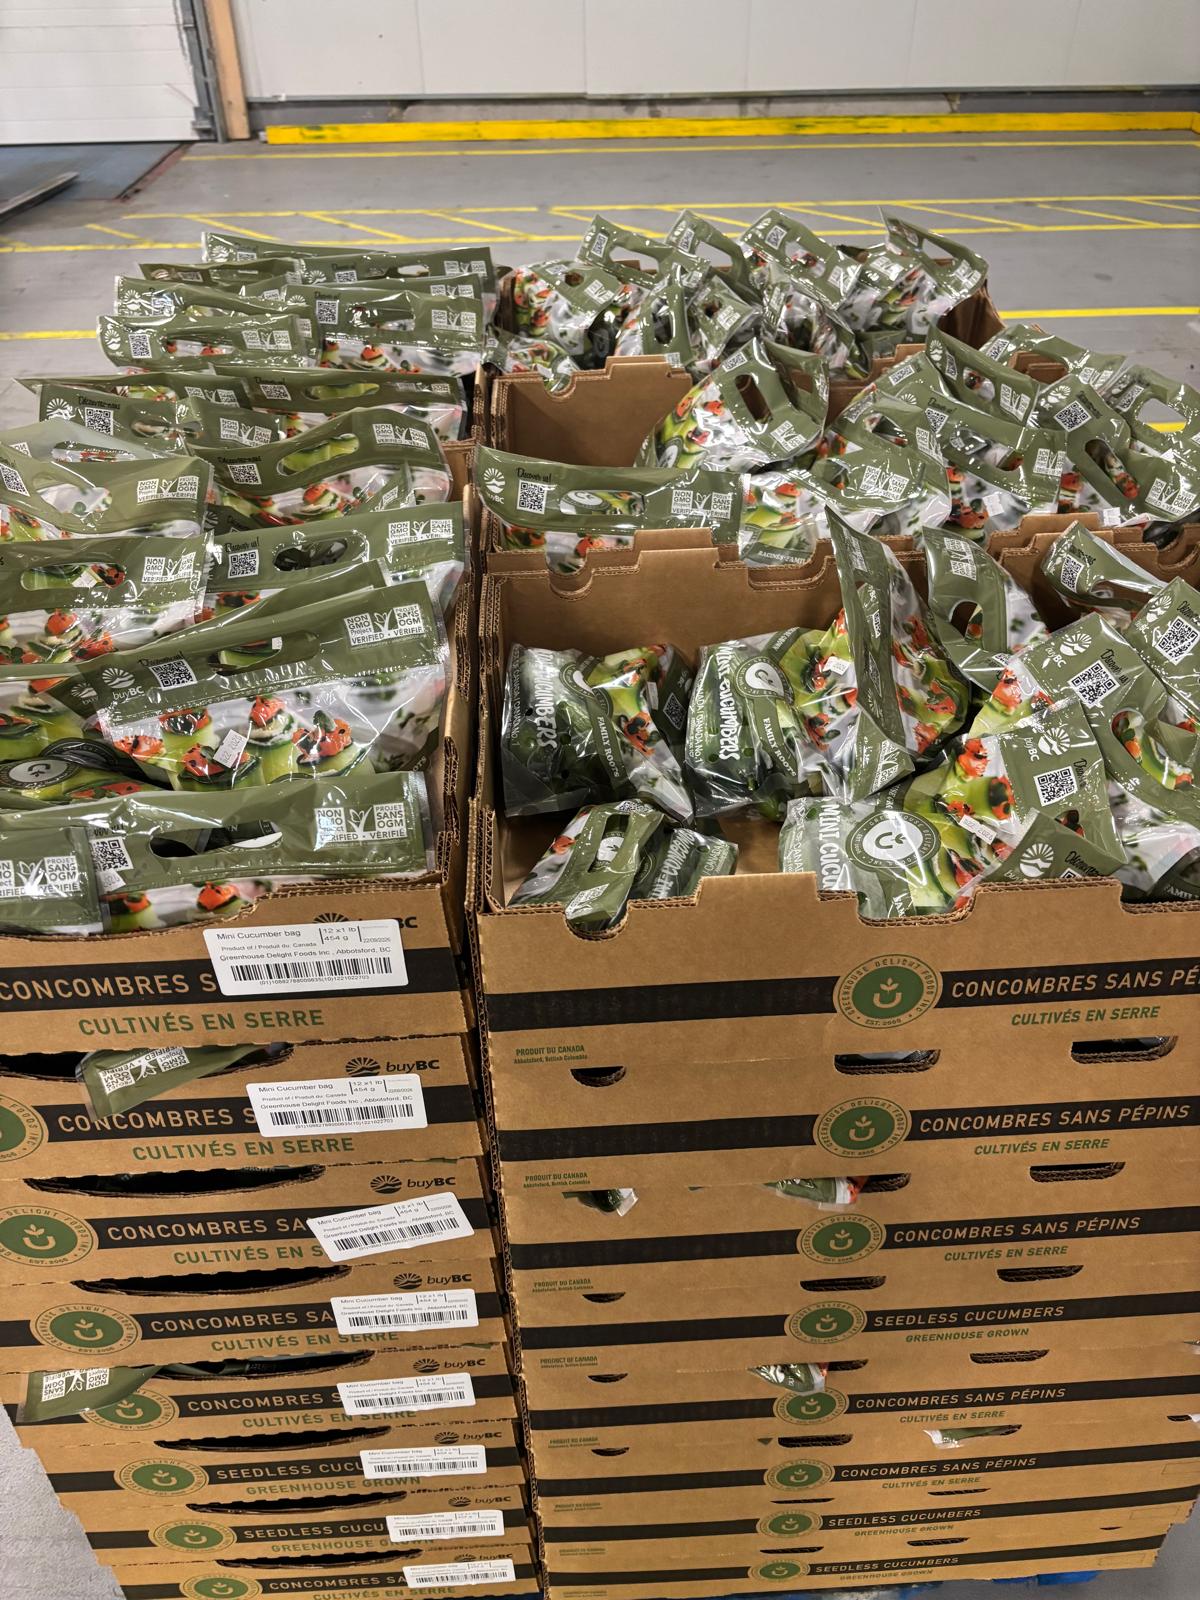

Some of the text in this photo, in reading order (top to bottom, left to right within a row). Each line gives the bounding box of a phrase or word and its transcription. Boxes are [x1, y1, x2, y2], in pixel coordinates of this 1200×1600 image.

[712, 498, 731, 506] SANS
[346, 614, 368, 624] NON
[397, 610, 420, 620] SANS
[348, 620, 370, 630] GMO
[398, 618, 421, 626] OGM
[350, 628, 372, 636] Project
[351, 633, 385, 644] VERIFIED
[112, 684, 145, 702] buyBC
[719, 677, 742, 761] CUCUMBERS
[597, 716, 620, 778] FAMILY ROOTS
[762, 716, 798, 778] FAMILY ROOTS
[317, 809, 342, 818] NON
[375, 804, 402, 812] PROJET
[376, 810, 404, 820] SANS
[377, 819, 404, 828] OGM
[819, 804, 841, 841] MINI
[48, 863, 76, 872] SANS
[49, 872, 76, 880] OGM
[237, 931, 282, 939] Cucumber
[220, 954, 265, 962] Greenhouse
[266, 952, 292, 960] Delight
[0, 974, 190, 1000] CONCOMBRES
[952, 974, 1097, 999] CONCOMBRES
[1104, 970, 1162, 991] SANS
[78, 1009, 325, 1036] CULTIVÉS EN SERRE
[1011, 1006, 1161, 1026] CULTIVÉS EN SERRE
[516, 1047, 546, 1056] PRODUIT
[558, 1045, 585, 1054] CANADA
[162, 1055, 186, 1067] GMO
[164, 1059, 187, 1070] NON
[386, 1059, 440, 1073] buyBC
[104, 1071, 130, 1083] OGM
[106, 1076, 130, 1088] SANS
[276, 1084, 316, 1092] Cucumber
[58, 1108, 234, 1133] CONCOMBRES
[919, 1104, 1192, 1134] CONCOMBRES SANS PÉPINS
[132, 1137, 355, 1160] CULTIVÉS EN SERRE
[974, 1138, 1110, 1156] CULTIVÉS EN SERRE
[406, 1176, 456, 1189] buyBC
[525, 1174, 552, 1182] PRODUIT
[564, 1172, 588, 1180] CANADA
[107, 1219, 268, 1242] CONCOMBRES
[893, 1217, 1142, 1243] CONCOMBRES SANS PÉPINS
[174, 1247, 269, 1264] CULTIVÉS
[277, 1246, 304, 1258] EN
[944, 1246, 1068, 1262] CULTIVÉS EN SERRE
[426, 1274, 472, 1285] buyBC
[150, 1312, 298, 1333] CONCOMBRES
[873, 1306, 1065, 1327] SEEDLESS CUCUMBERS
[210, 1332, 400, 1352] CULTIVÉS EN SERRE
[905, 1328, 1030, 1344] GREENHOUSE GROWN
[444, 1358, 486, 1369] buyBC
[88, 1374, 108, 1382] GMO
[88, 1380, 107, 1388] NON
[44, 1380, 64, 1390] OGM
[44, 1386, 64, 1396] SANS
[187, 1394, 324, 1412] CONCOMBRES
[856, 1388, 1066, 1409] CONCOMBRES SANS PÉPINS
[242, 1412, 354, 1428] CULTIVÉS EN
[900, 1410, 1006, 1424] CULTIVÉS EN SERRE
[462, 1432, 502, 1440] buyBC
[216, 1464, 312, 1480] SEEDLESS
[840, 1458, 1038, 1478] CONCOMBRES SANS PÉPINS
[948, 1477, 981, 1485] SERRE
[246, 1480, 360, 1496] GREENHOUSE
[474, 1496, 512, 1504] buyBC
[828, 1509, 982, 1528] SEEDLESS CUCUMBERS
[243, 1526, 334, 1539] SEEDLESS
[854, 1528, 917, 1537] GREENHOUSE
[272, 1538, 375, 1553] GREENHOUSE
[816, 1557, 959, 1574] SEEDLESS CUCUMBERS
[269, 1576, 384, 1591] CONCOMBRES
[386, 1590, 404, 1598] EN
